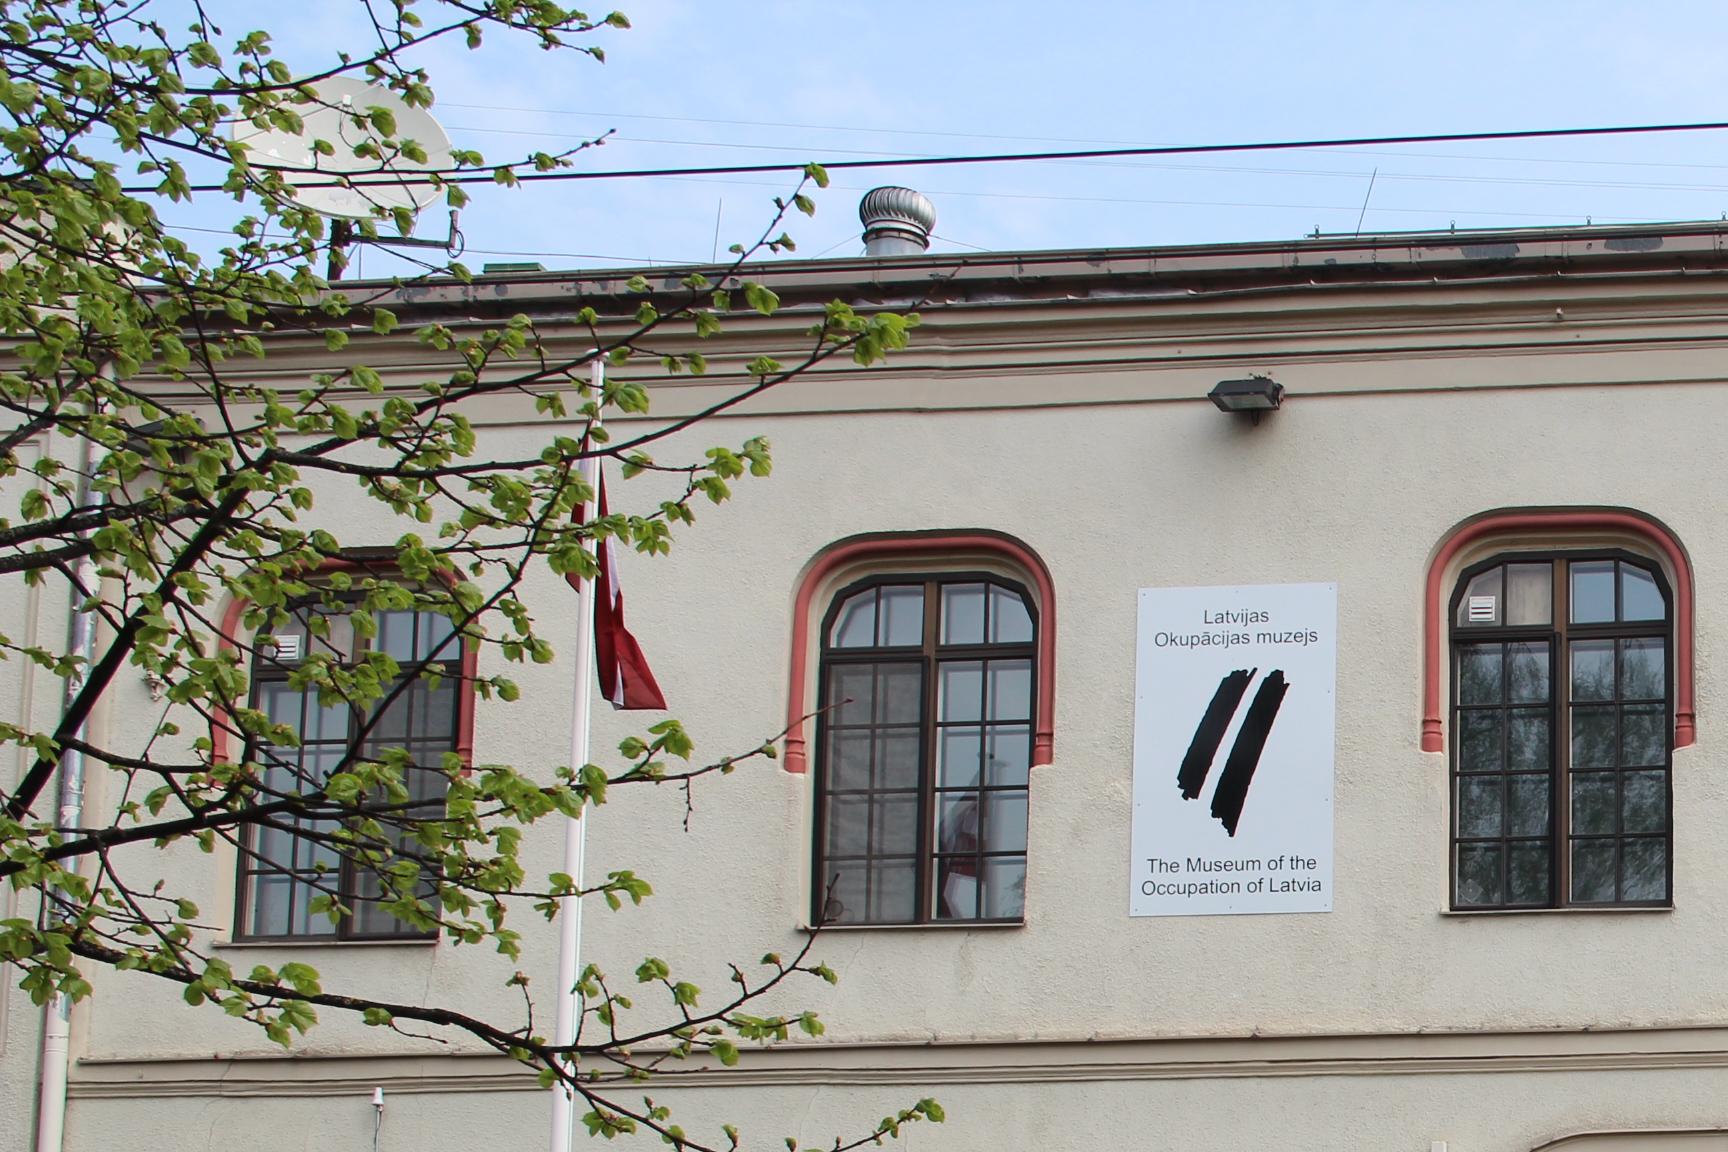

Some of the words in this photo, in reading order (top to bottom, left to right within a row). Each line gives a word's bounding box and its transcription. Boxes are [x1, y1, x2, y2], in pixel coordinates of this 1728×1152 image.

[1204, 609, 1269, 627] Latvijas
[1154, 631, 1250, 649] Okupācijas
[1256, 630, 1318, 647] muzejs
[1148, 859, 1180, 873] The
[1187, 858, 1261, 872] Museum
[1268, 856, 1284, 870] of
[1290, 856, 1317, 870] the
[1142, 879, 1240, 898] Occupation
[1247, 878, 1264, 893] of
[1270, 878, 1322, 892] Latvia
